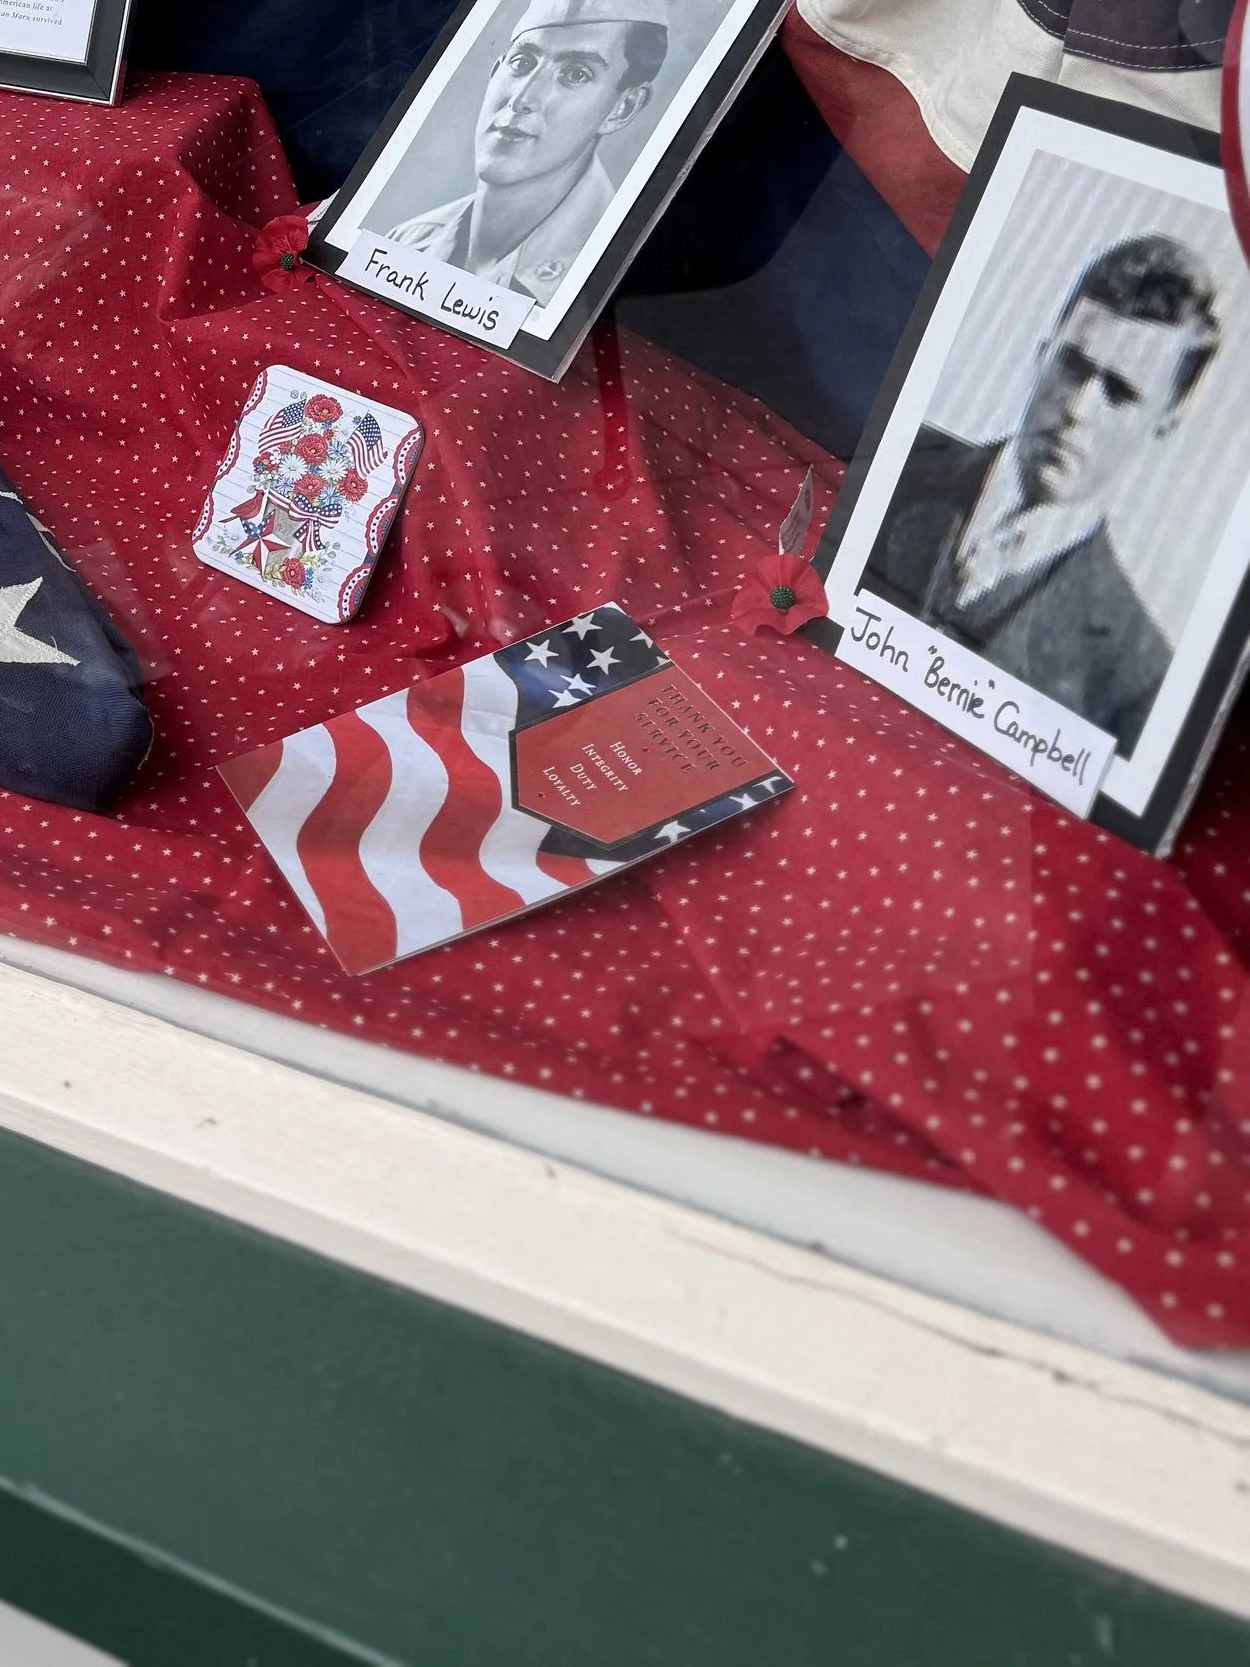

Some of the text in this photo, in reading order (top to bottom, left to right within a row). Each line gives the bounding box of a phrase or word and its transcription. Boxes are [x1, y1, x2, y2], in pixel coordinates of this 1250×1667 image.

[364, 248, 500, 331] Frank Lewis
[648, 698, 720, 770] FOR YOUR
[662, 684, 748, 767] THANK YOU
[850, 607, 909, 673] John
[993, 700, 1091, 785] Campbell
[635, 713, 696, 773] SERVICE
